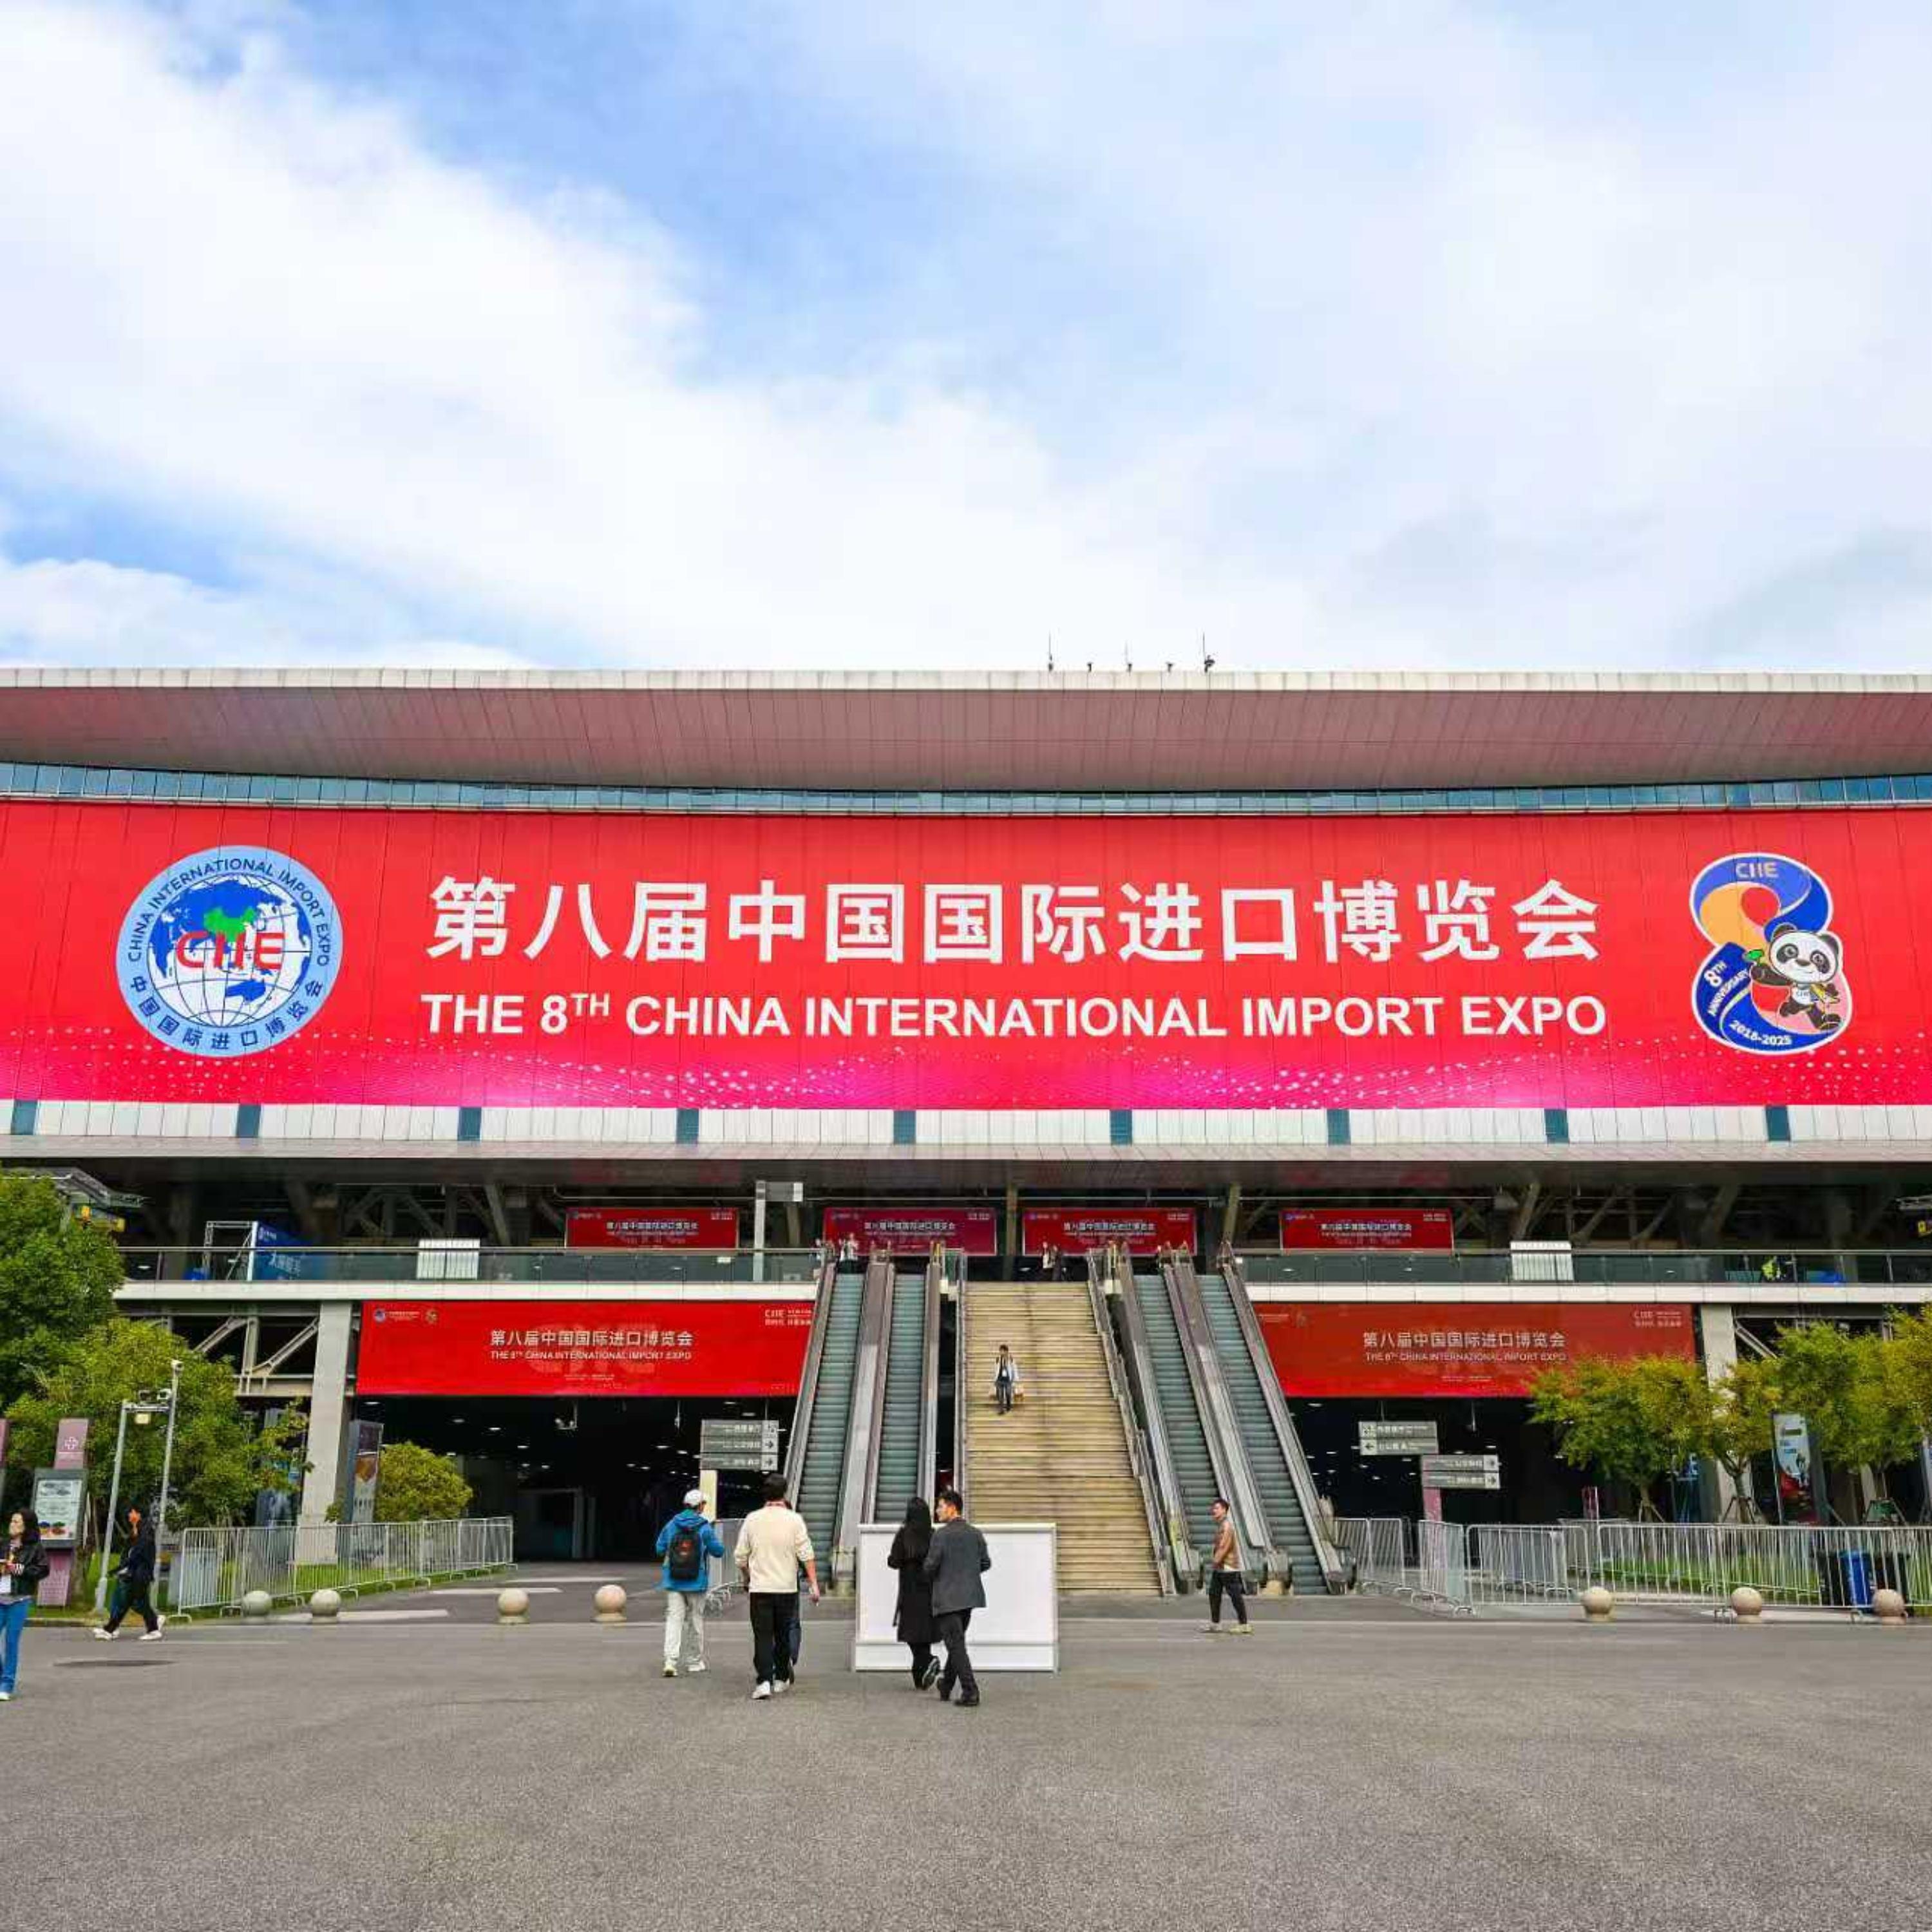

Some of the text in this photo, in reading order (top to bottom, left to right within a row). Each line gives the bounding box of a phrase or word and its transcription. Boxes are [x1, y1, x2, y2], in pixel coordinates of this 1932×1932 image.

[1736, 862, 1779, 878] CIIE
[128, 858, 331, 967] CHINA INTERNATIONAL IMPORT EXPO
[426, 876, 1598, 963] 第八届中国国际进口博览会
[176, 931, 285, 970] CIIE
[1703, 960, 1728, 987] 8TH
[130, 975, 323, 1050] 中国国际进口博览会
[421, 994, 1605, 1036] THE 8TH CHINA INTERNATIONAL IMPORT EXPO
[490, 1329, 694, 1347] 第八届中国国际进口博览会
